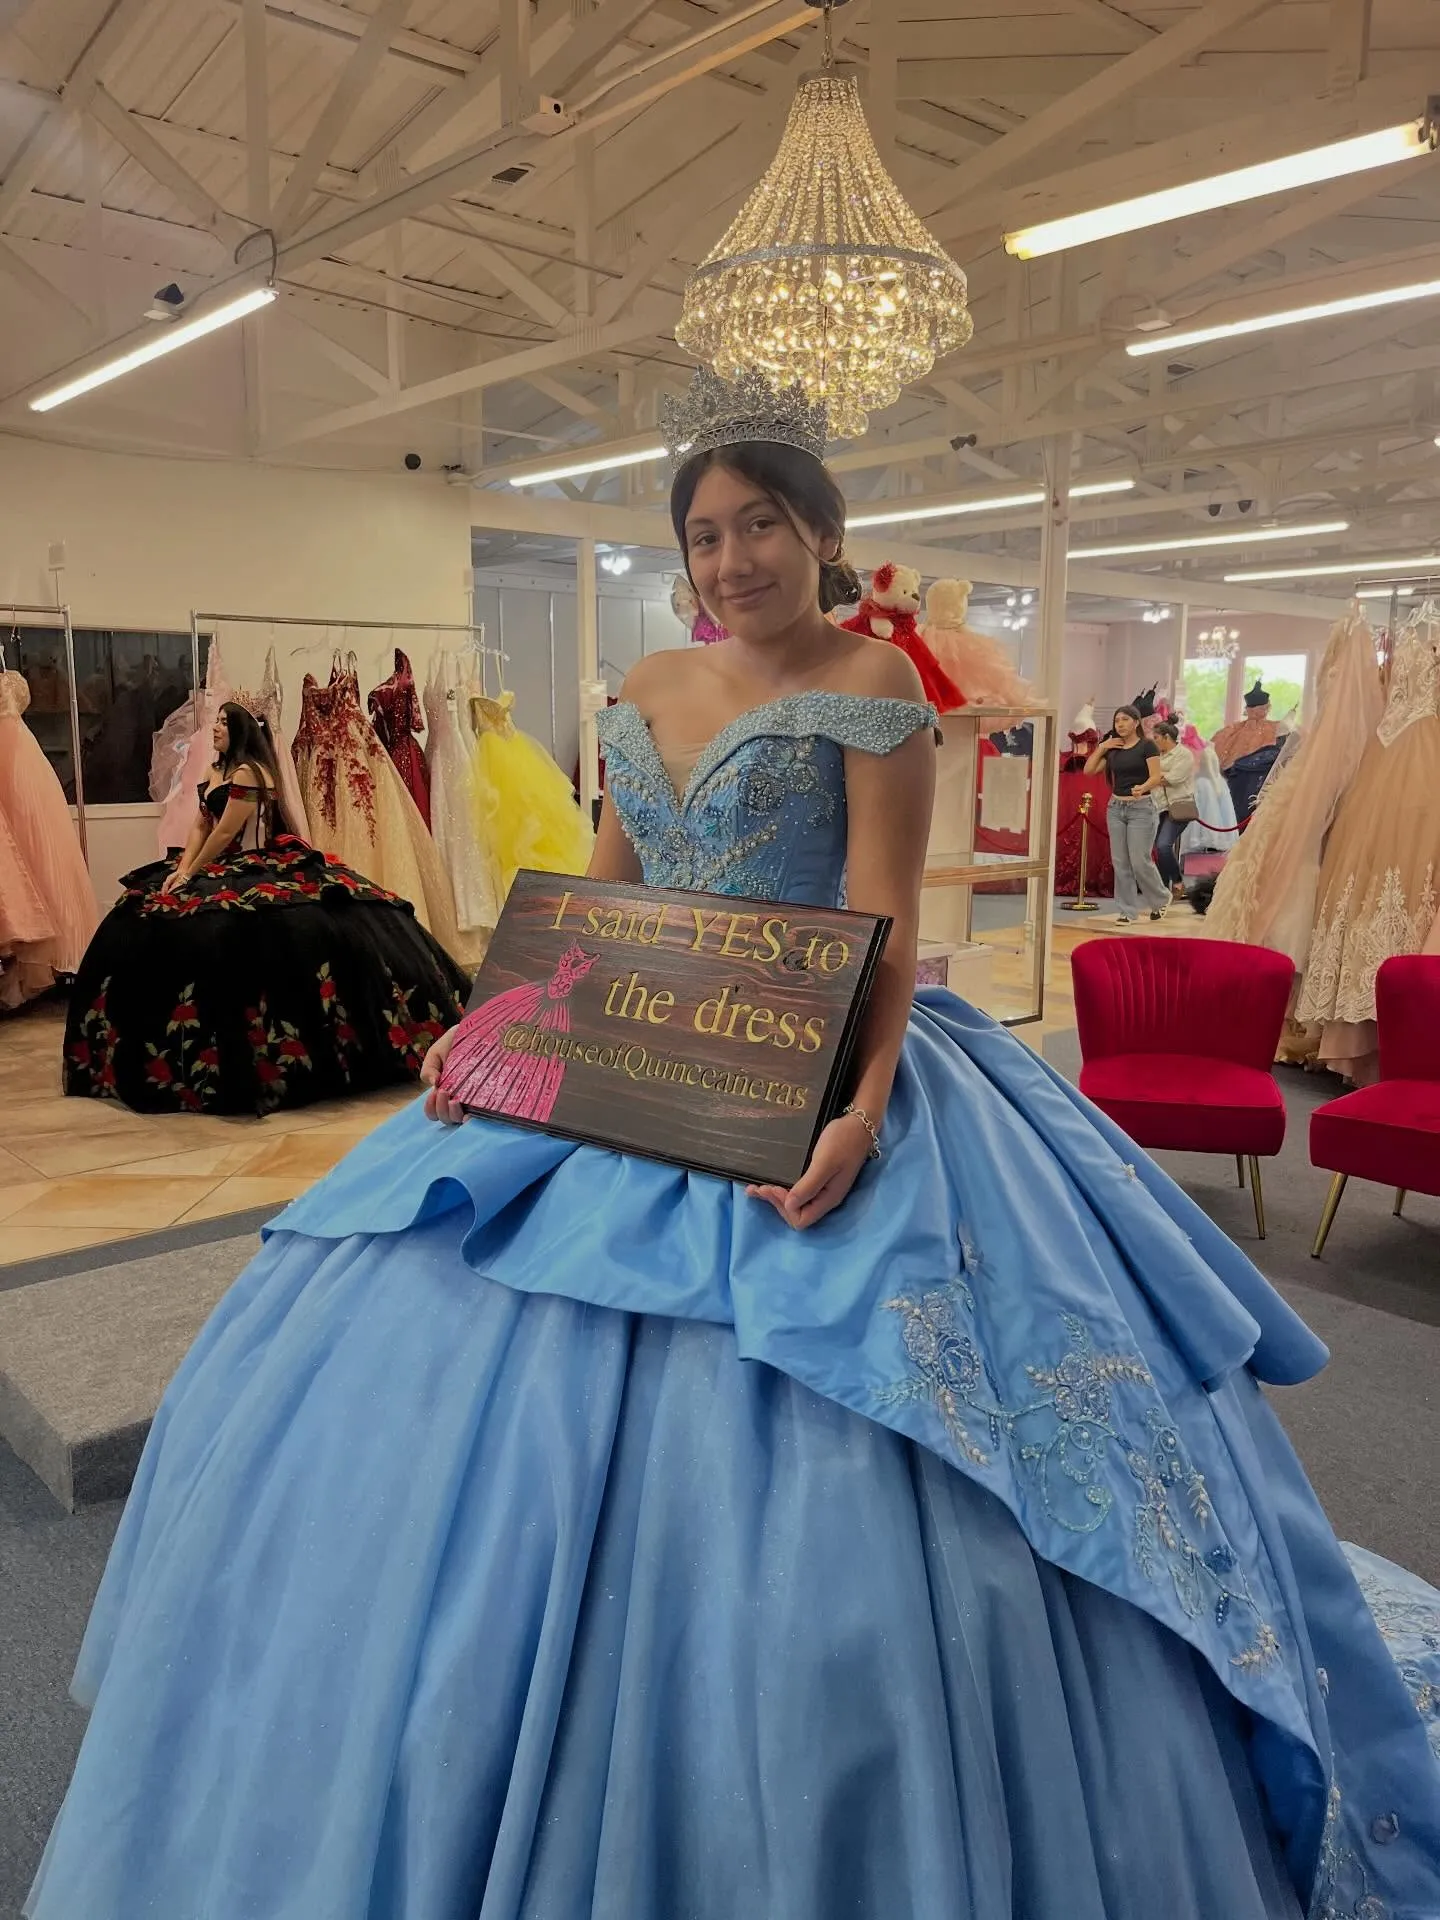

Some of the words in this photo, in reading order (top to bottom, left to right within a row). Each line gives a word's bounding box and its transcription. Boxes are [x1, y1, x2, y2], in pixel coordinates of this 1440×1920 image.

[550, 890, 574, 931] I
[582, 903, 669, 946] said
[690, 908, 789, 963] YES
[803, 931, 850, 973] to
[603, 972, 675, 1024] the
[694, 985, 826, 1053] dress
[502, 1023, 808, 1110] @houseofQuinceañeras
